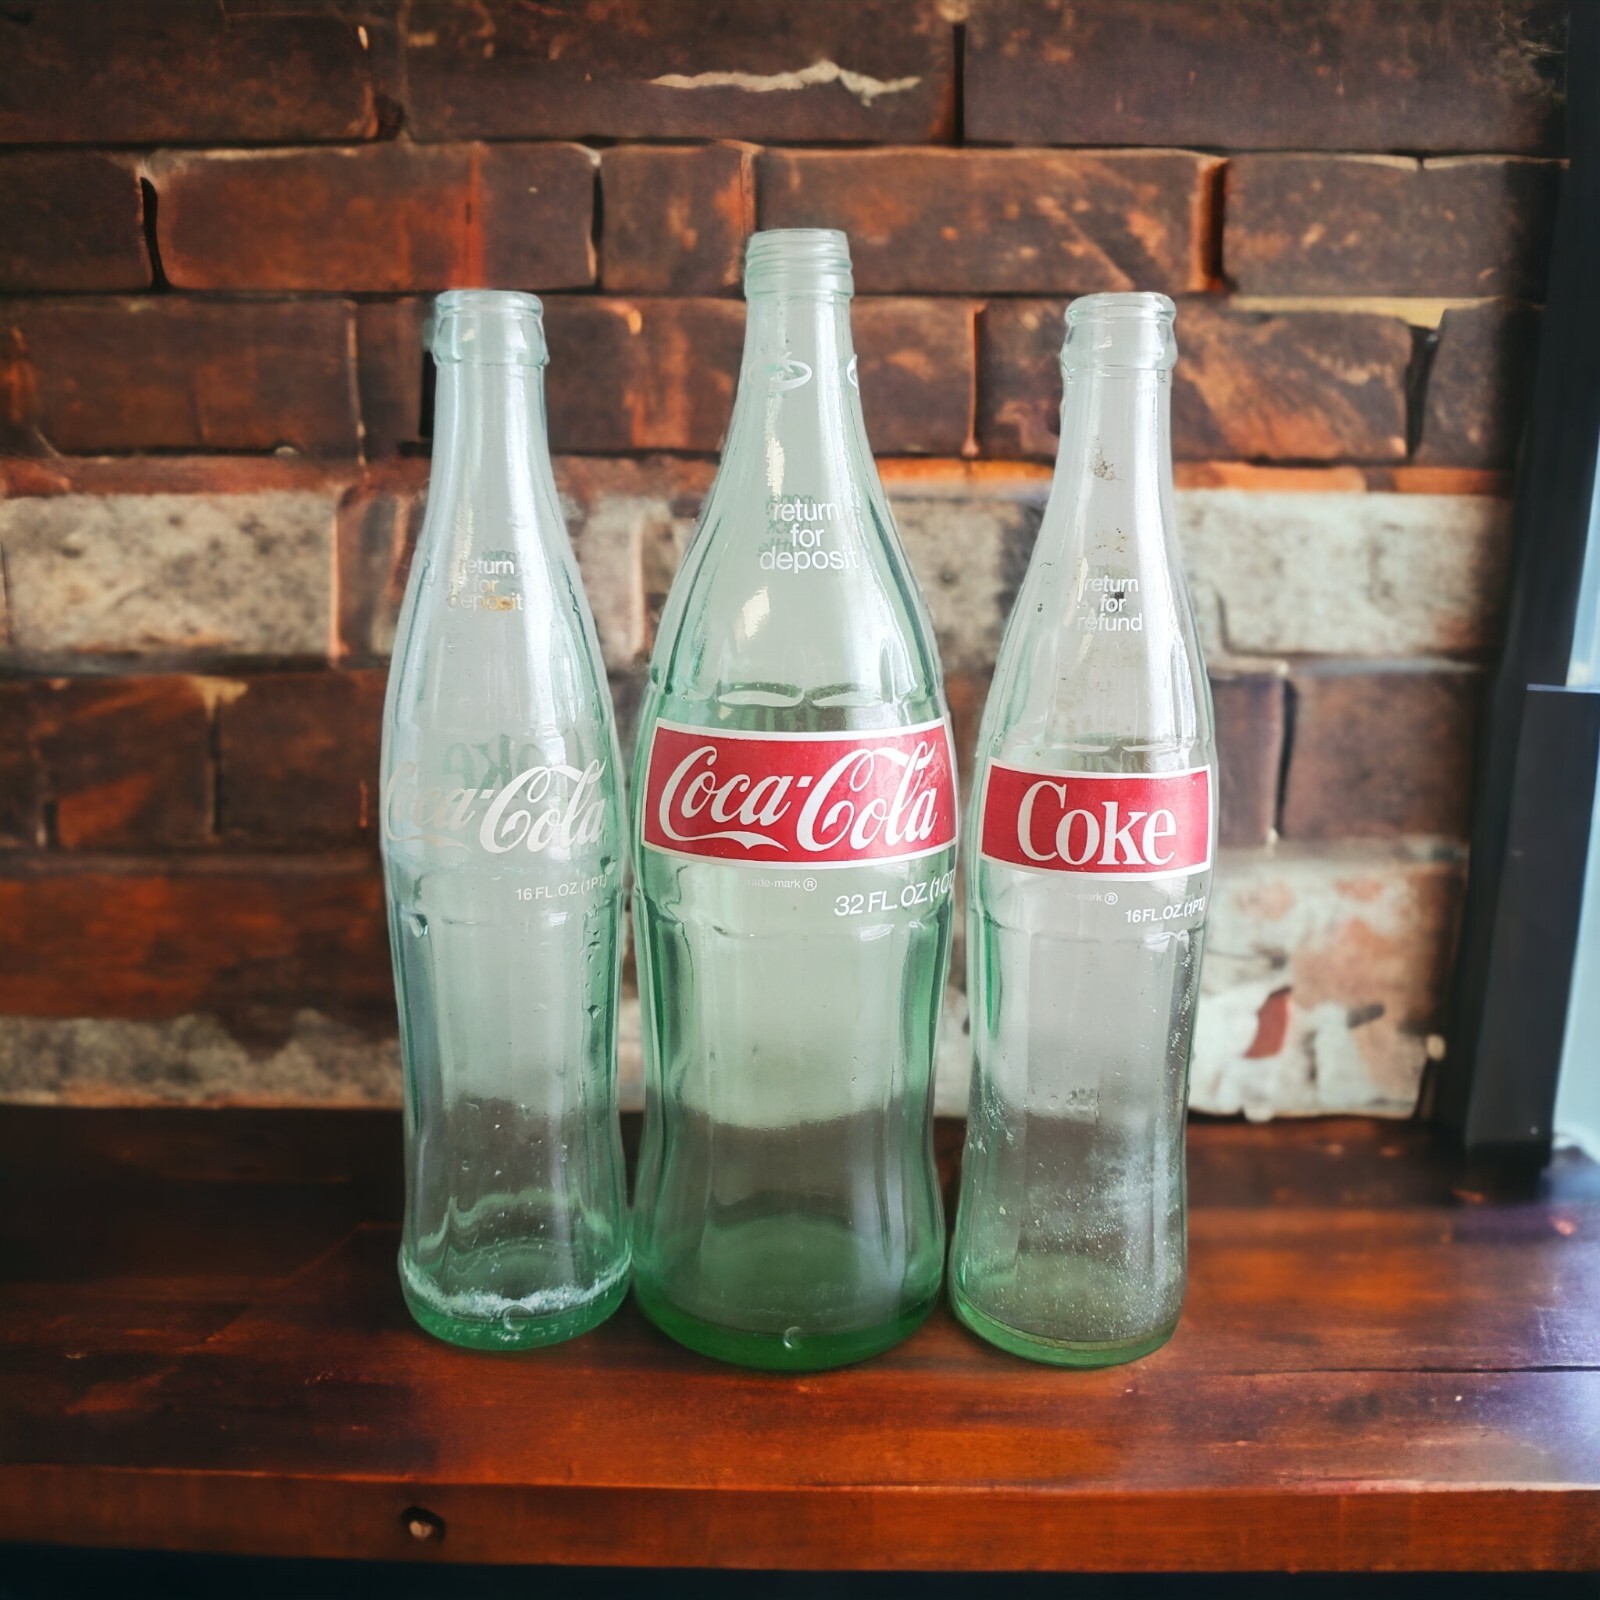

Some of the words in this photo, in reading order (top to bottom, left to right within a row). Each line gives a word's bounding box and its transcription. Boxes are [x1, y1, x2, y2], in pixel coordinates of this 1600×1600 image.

[773, 499, 839, 521] return
[790, 523, 824, 547] for
[760, 545, 860, 574] deposit
[1084, 574, 1139, 592] return
[1100, 593, 1127, 613] for
[1077, 612, 1143, 631] refund
[658, 739, 939, 852] Coca-Cola
[1017, 780, 1178, 866] Coke
[516, 888, 533, 901] 16
[834, 894, 864, 916] 32
[1125, 909, 1141, 923] 16
